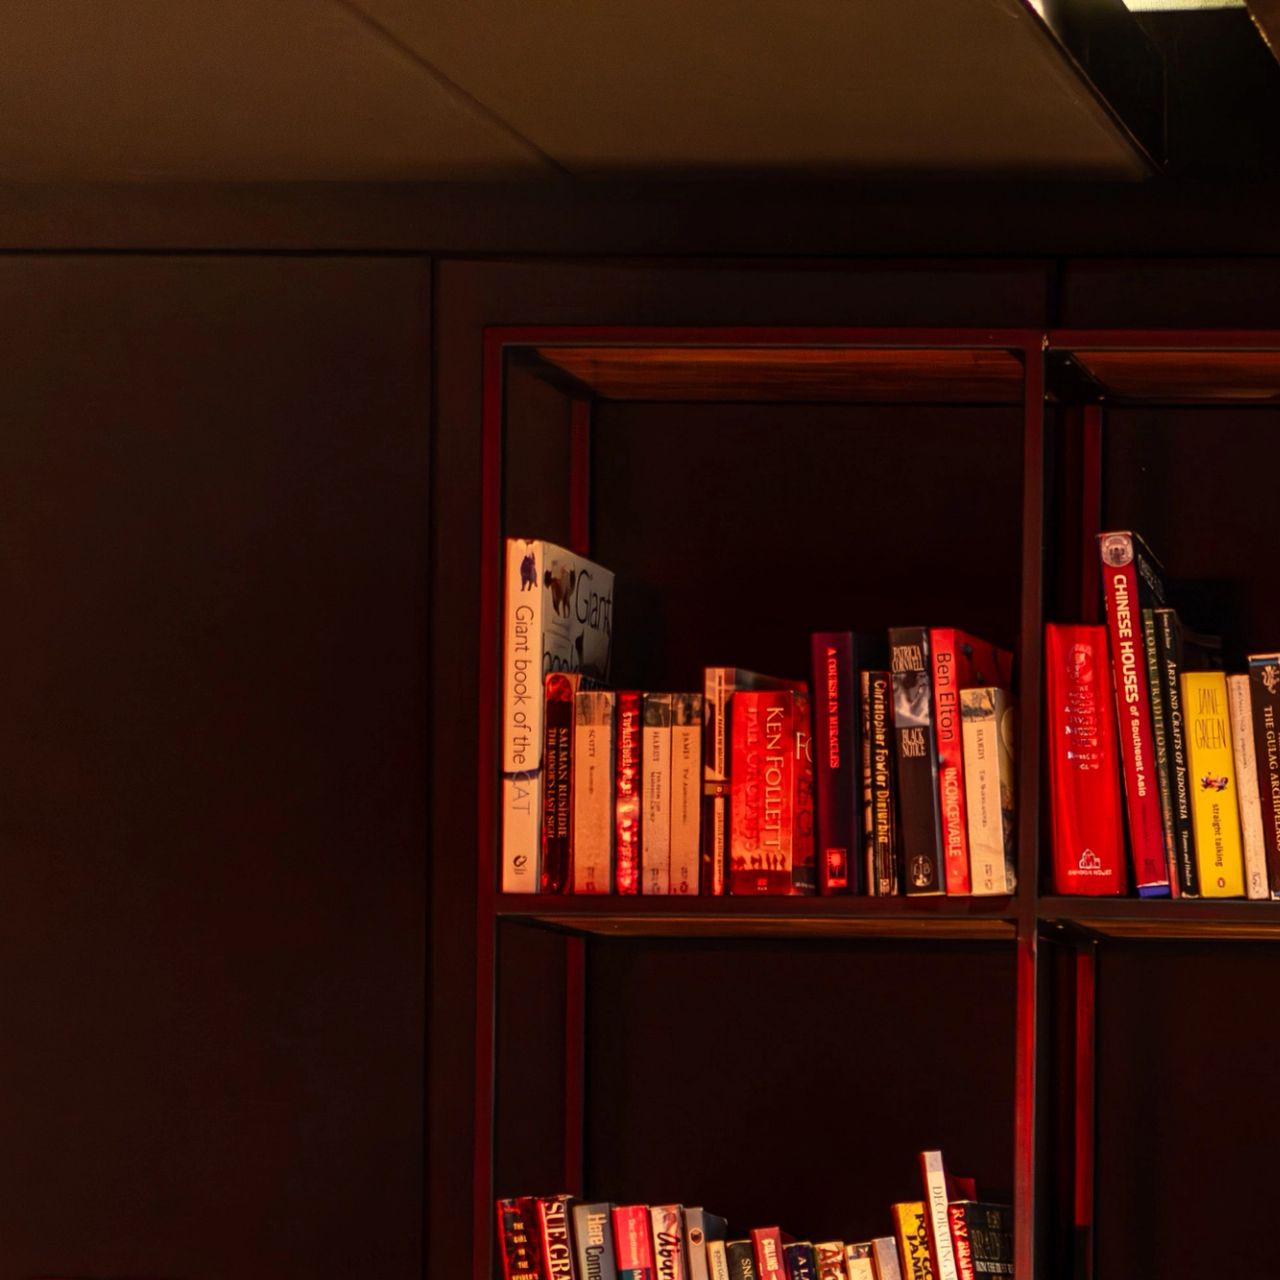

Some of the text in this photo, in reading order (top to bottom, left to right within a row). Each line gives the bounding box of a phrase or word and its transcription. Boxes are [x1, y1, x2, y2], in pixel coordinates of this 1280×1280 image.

[1114, 574, 1148, 797] CHINESE HOUSES of Southeast Asia
[1145, 621, 1167, 764] FLORAL TRADITIONS
[1167, 660, 1177, 688] ARTS
[512, 606, 534, 815] Giant book of the CAT
[828, 648, 839, 768] A COURSE IN MIRACLES
[547, 728, 556, 748] THE
[902, 728, 923, 743] BLACK
[1171, 711, 1183, 749] CRAFTS
[873, 680, 889, 843] Christopher Fowler Disturbia
[937, 653, 961, 856] Ben Elton INCONCEIVABLE
[1175, 751, 1183, 764] OF
[558, 728, 568, 838] SALMAN RUSHDIE
[765, 707, 784, 850] KEN FOLLETT
[1176, 766, 1188, 819] INDONESIA
[547, 790, 556, 812] LAST
[546, 816, 556, 838] SIGH
[1212, 803, 1225, 867] straight talking
[545, 1202, 567, 1239] SUE
[587, 1213, 606, 1244] Here
[916, 1214, 930, 1253] POP
[950, 1209, 968, 1236] RAY
